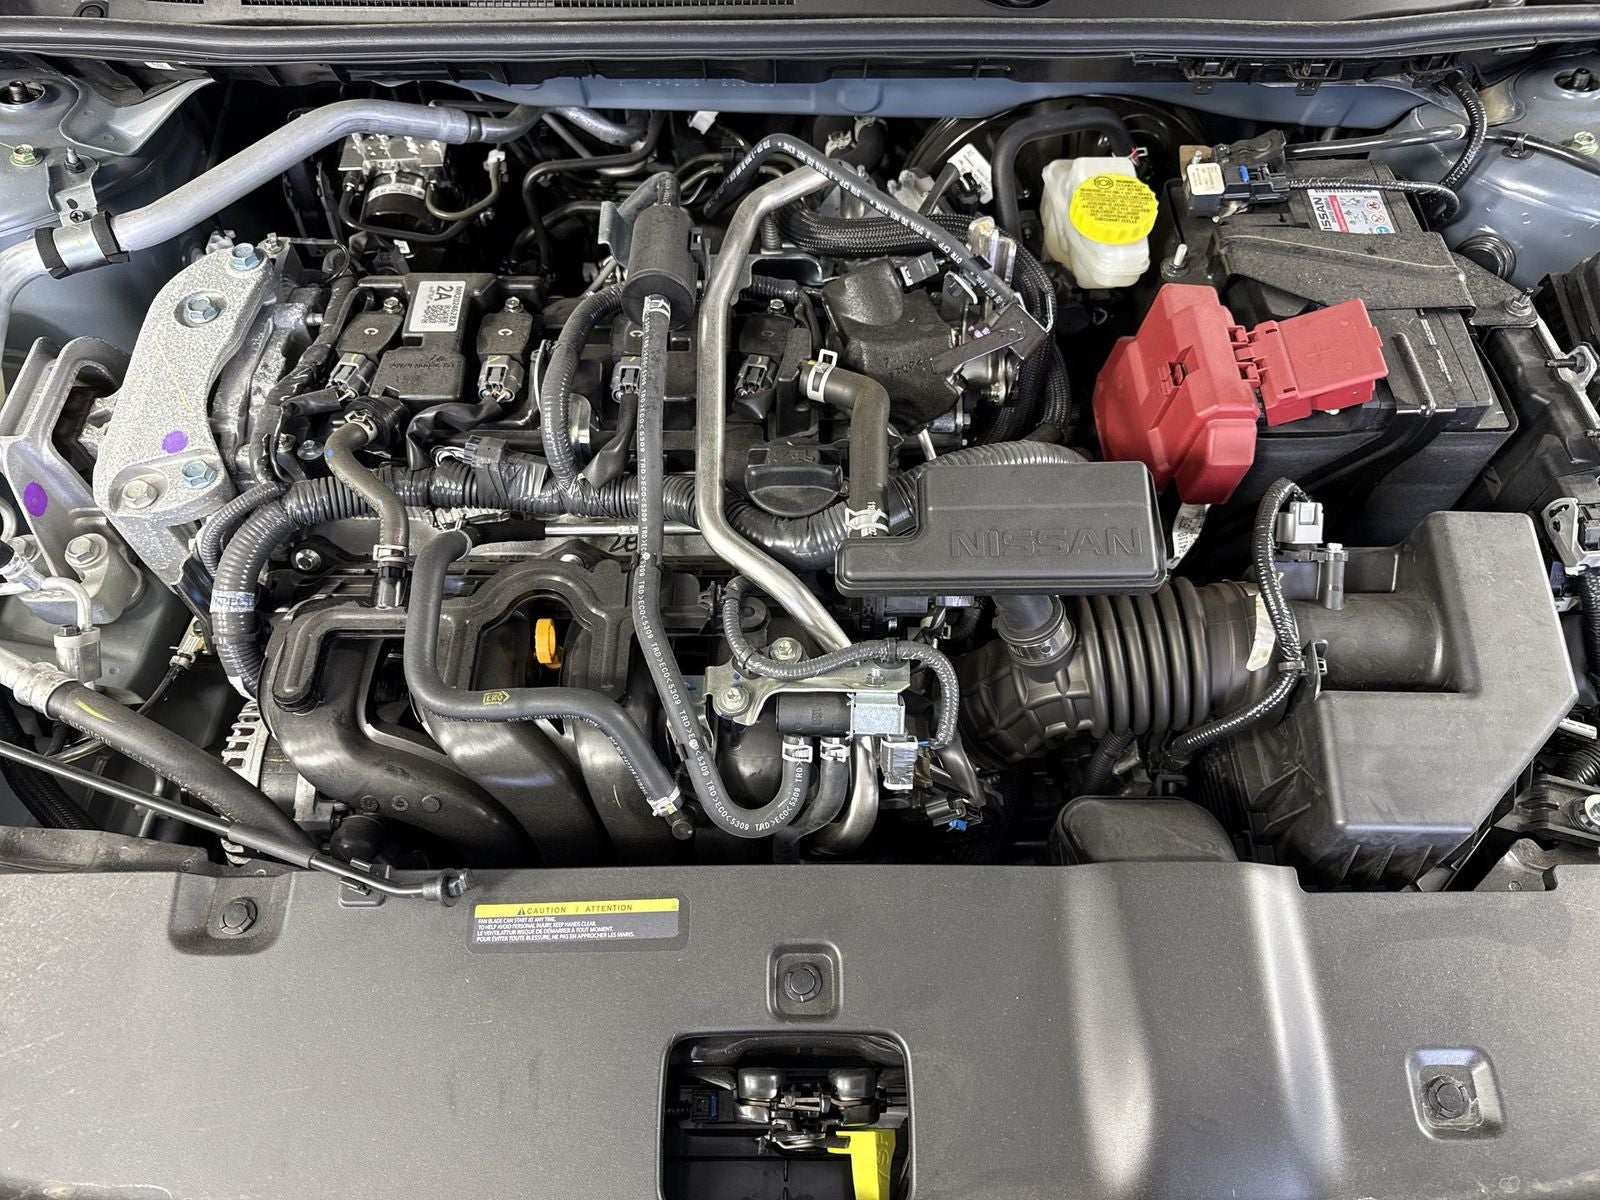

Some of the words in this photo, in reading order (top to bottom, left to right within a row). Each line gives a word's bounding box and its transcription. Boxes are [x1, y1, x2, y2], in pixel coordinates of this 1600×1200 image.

[1313, 197, 1332, 230] ISSAN
[434, 285, 454, 302] 2A
[951, 527, 1143, 557] NISSAN
[527, 907, 566, 915] CAUTION
[585, 904, 633, 912] ATTENTION
